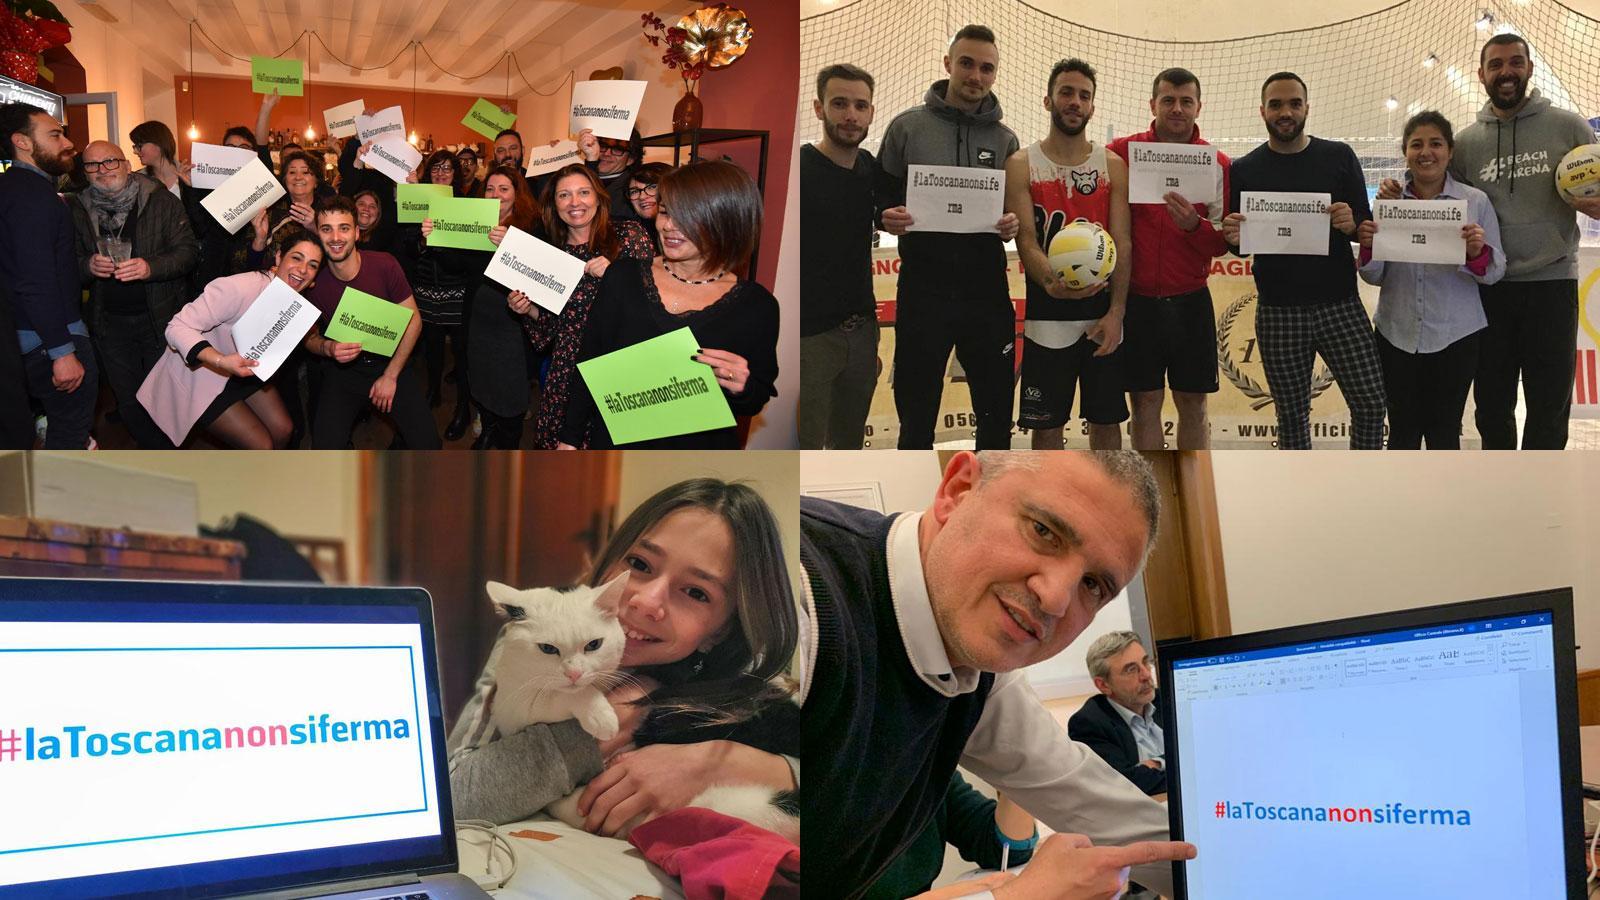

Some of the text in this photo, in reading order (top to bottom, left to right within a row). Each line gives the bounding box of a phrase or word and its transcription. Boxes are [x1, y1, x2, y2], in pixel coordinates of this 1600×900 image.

[1134, 147, 1212, 166] #laToscananonsife
[1566, 158, 1595, 171] Wilson
[913, 171, 1000, 191] #laToscananonsife
[1165, 177, 1180, 188] rma
[222, 180, 274, 223] #laToscananonsiferma
[947, 203, 963, 214] rma
[1246, 197, 1326, 214] #laToscananonsife
[1379, 204, 1462, 221] #laToscananonsife
[433, 219, 492, 234] #laToscananonsiferma
[1277, 226, 1292, 237] rma
[1096, 235, 1105, 261] Wilson
[1411, 233, 1427, 245] rma
[500, 250, 566, 295] #laToscananonsiferma
[339, 311, 398, 341] #laToscananonsiferma
[603, 376, 709, 415] #laToscananonsiferma
[0, 713, 411, 762] #laToscananonsiferma
[1215, 801, 1472, 826] #laToscananonsiferma
